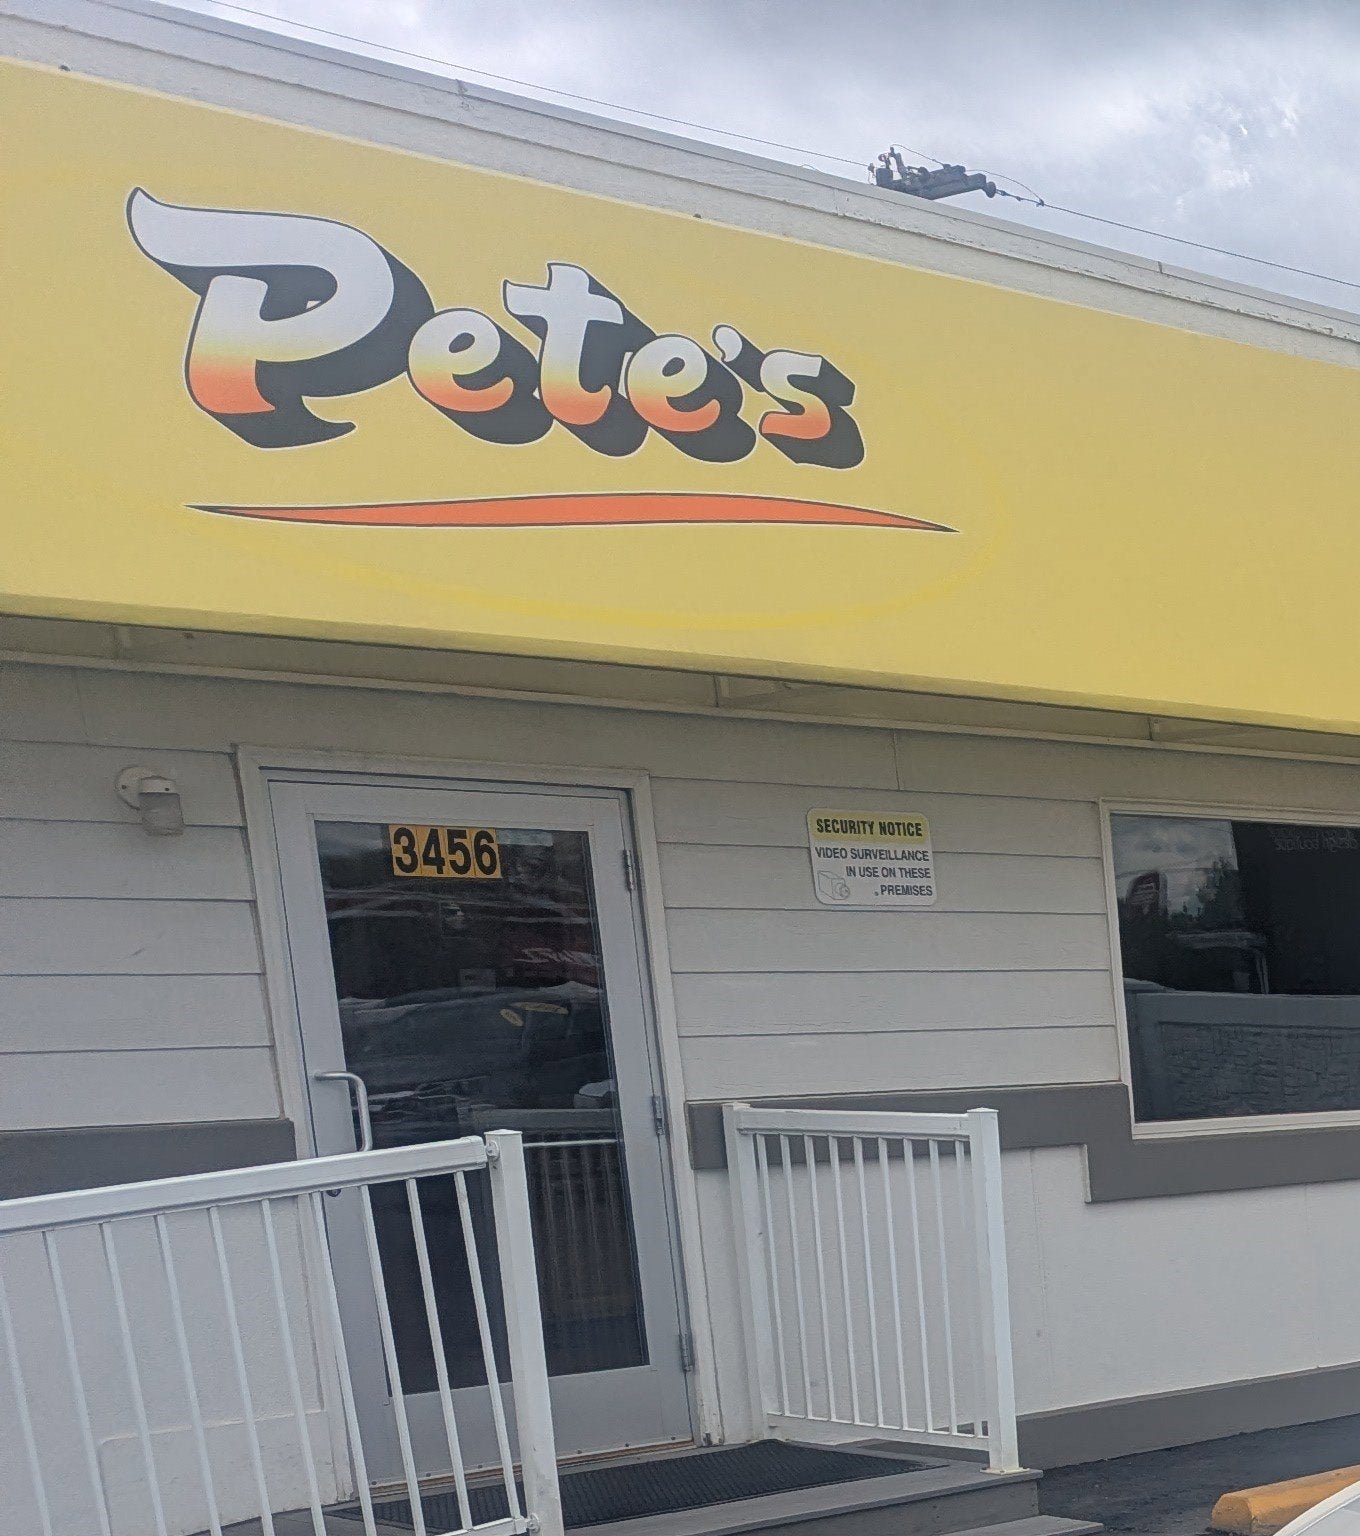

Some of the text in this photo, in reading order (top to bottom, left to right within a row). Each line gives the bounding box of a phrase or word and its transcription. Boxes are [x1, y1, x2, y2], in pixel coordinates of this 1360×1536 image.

[127, 187, 864, 469] Pete's
[816, 818, 923, 837] SECURITY NOTICE
[393, 827, 498, 875] 3456
[815, 846, 930, 861] VIDEO SURVEILLANCE
[845, 865, 931, 879] IN USE ON THESE
[880, 884, 933, 896] PREMISES
